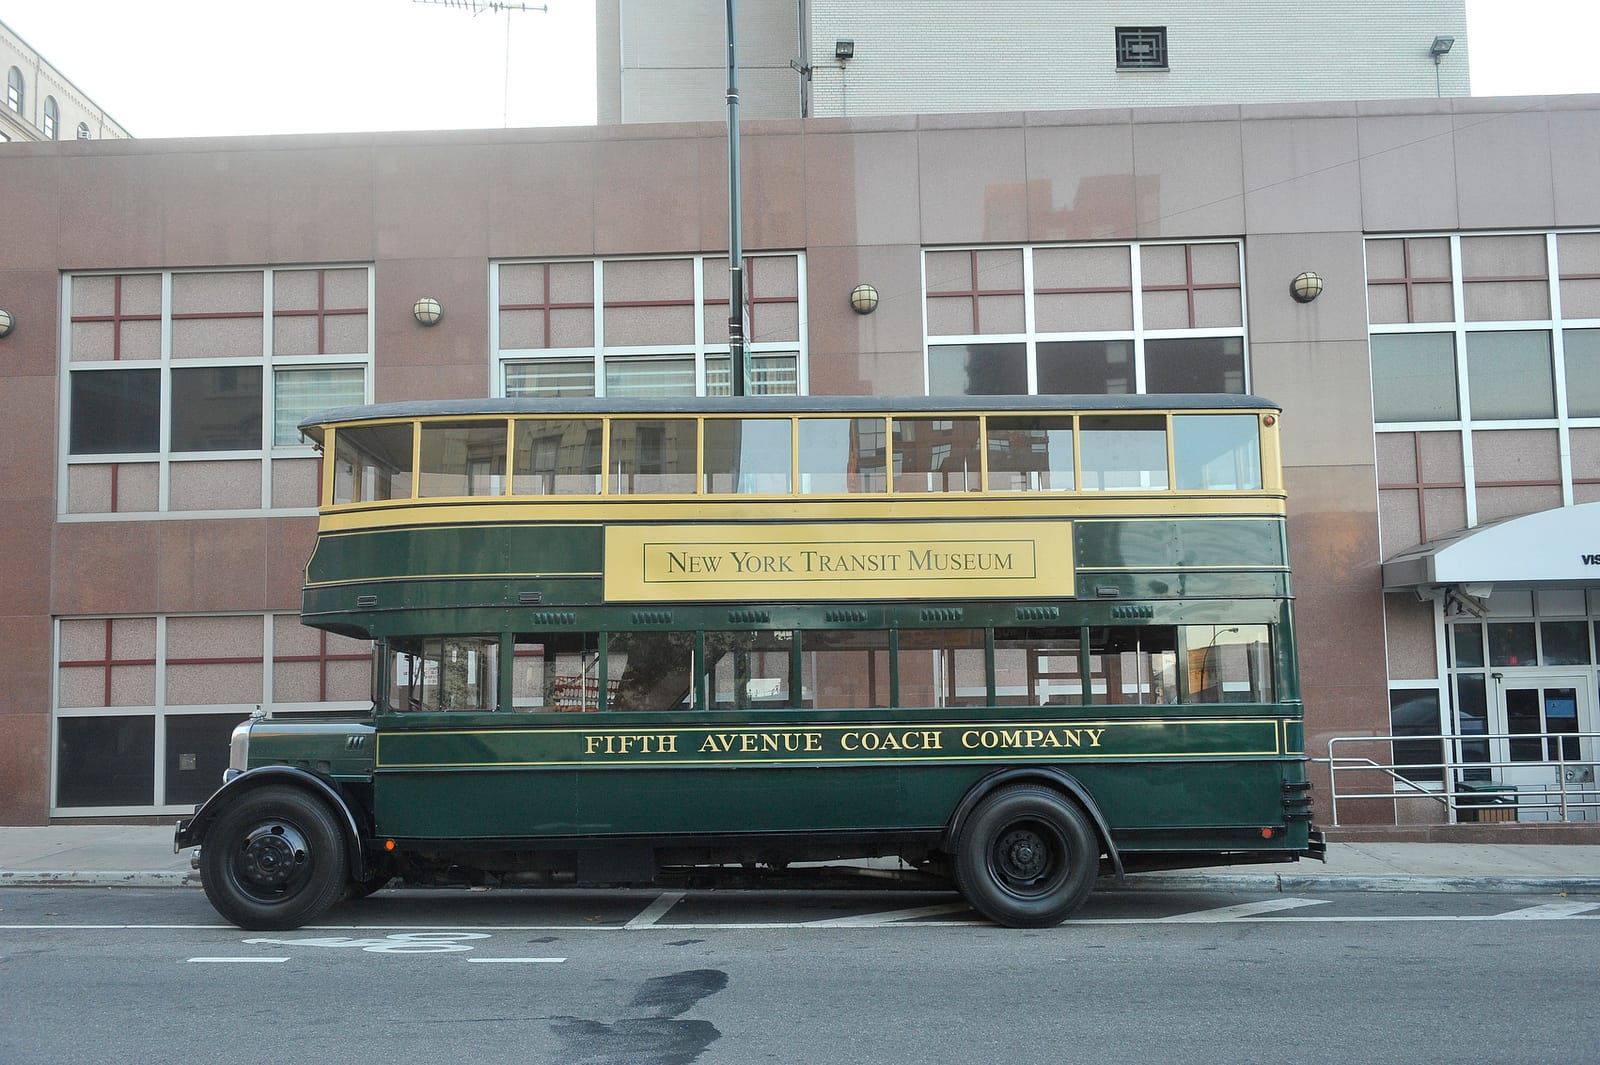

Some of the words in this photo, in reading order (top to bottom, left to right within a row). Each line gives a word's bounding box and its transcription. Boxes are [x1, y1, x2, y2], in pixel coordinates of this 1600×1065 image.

[667, 551, 722, 573] NEW
[730, 551, 793, 572] YORK
[799, 550, 900, 571] TRANSIT
[909, 549, 1012, 571] MUSEUM
[585, 735, 678, 754] FIFTH
[699, 733, 823, 752] AVENUE
[840, 731, 943, 751] COACH
[961, 729, 1106, 748] COMPANY
